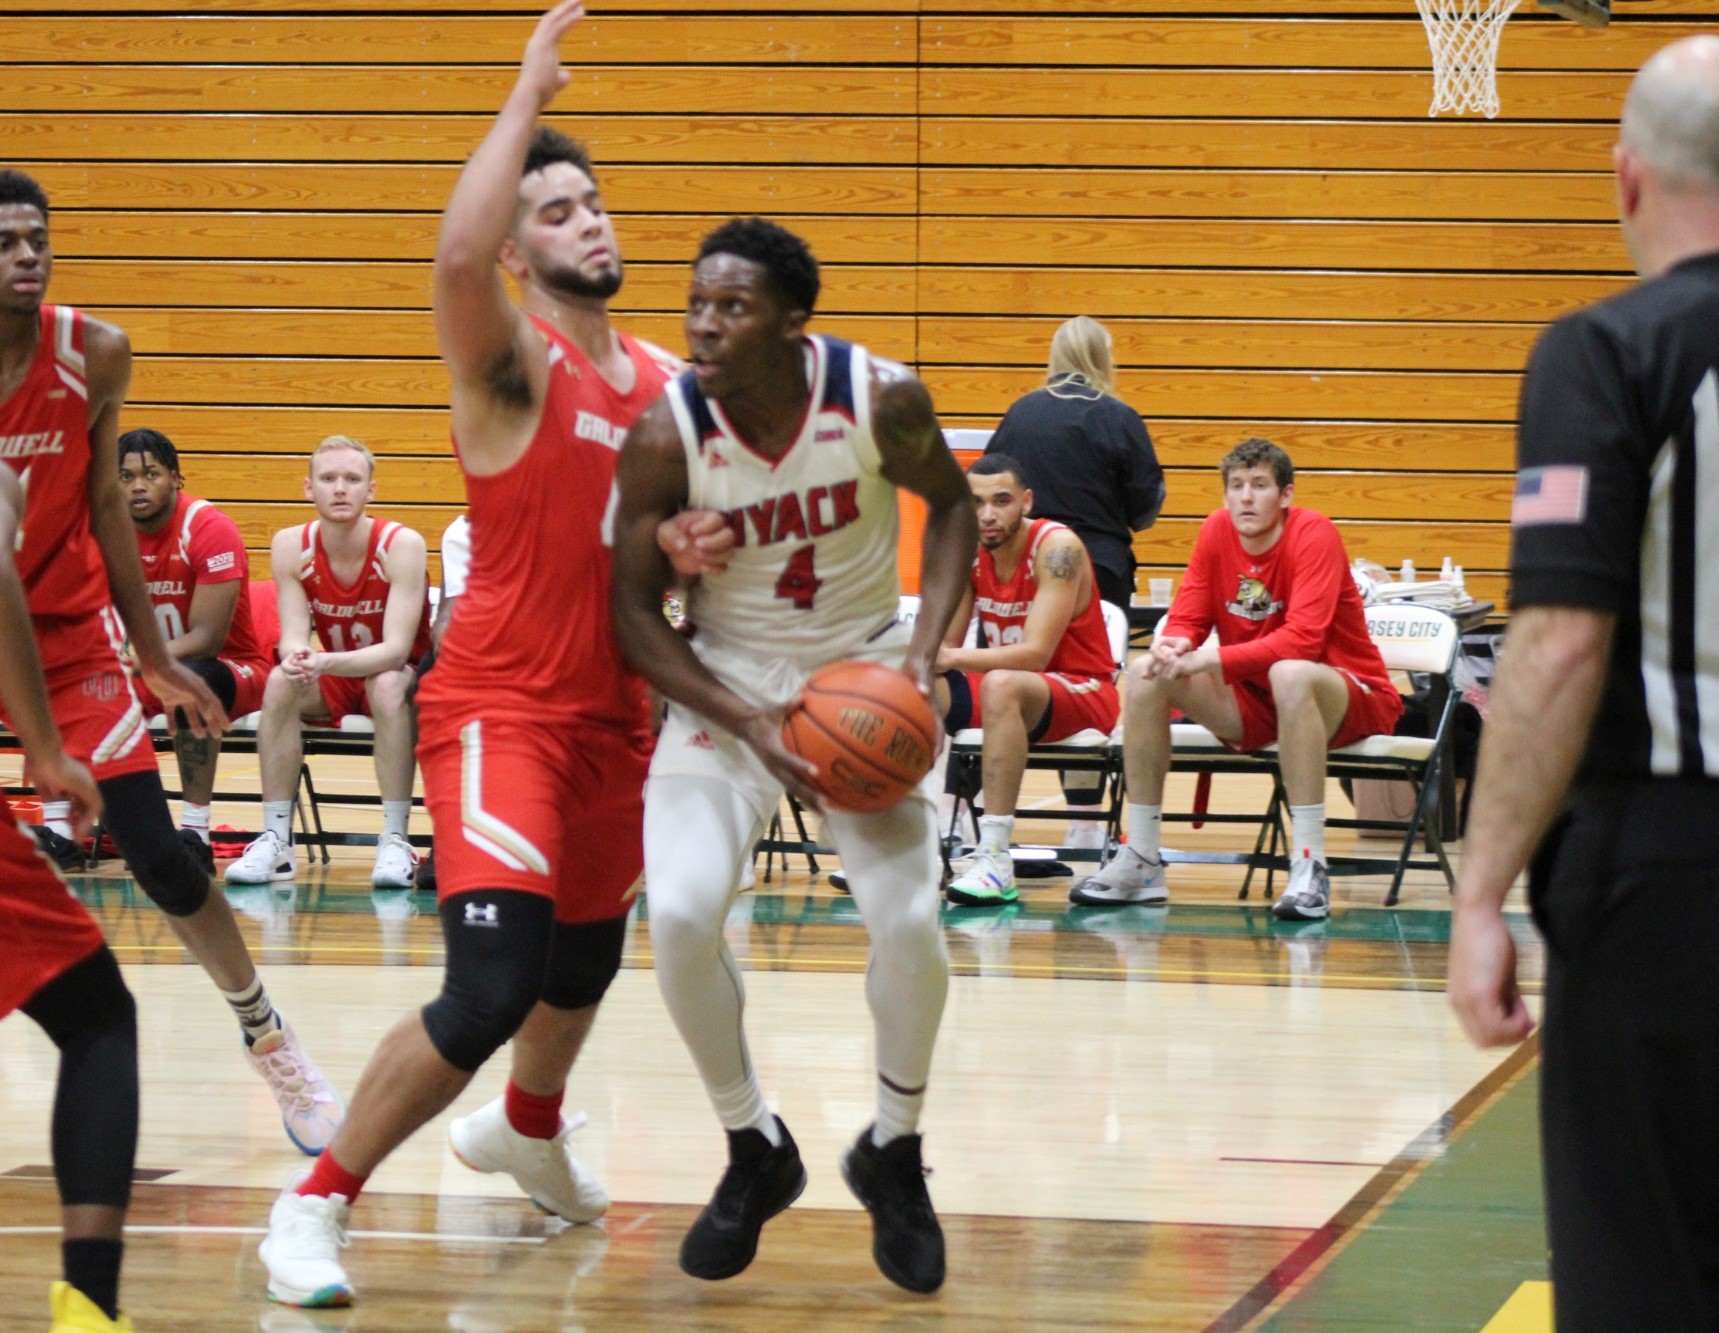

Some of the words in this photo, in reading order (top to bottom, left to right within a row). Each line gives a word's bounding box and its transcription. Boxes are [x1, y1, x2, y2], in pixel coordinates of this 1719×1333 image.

[773, 543, 823, 610] 4
[1409, 621, 1442, 637] CITY
[838, 706, 885, 747] THE
